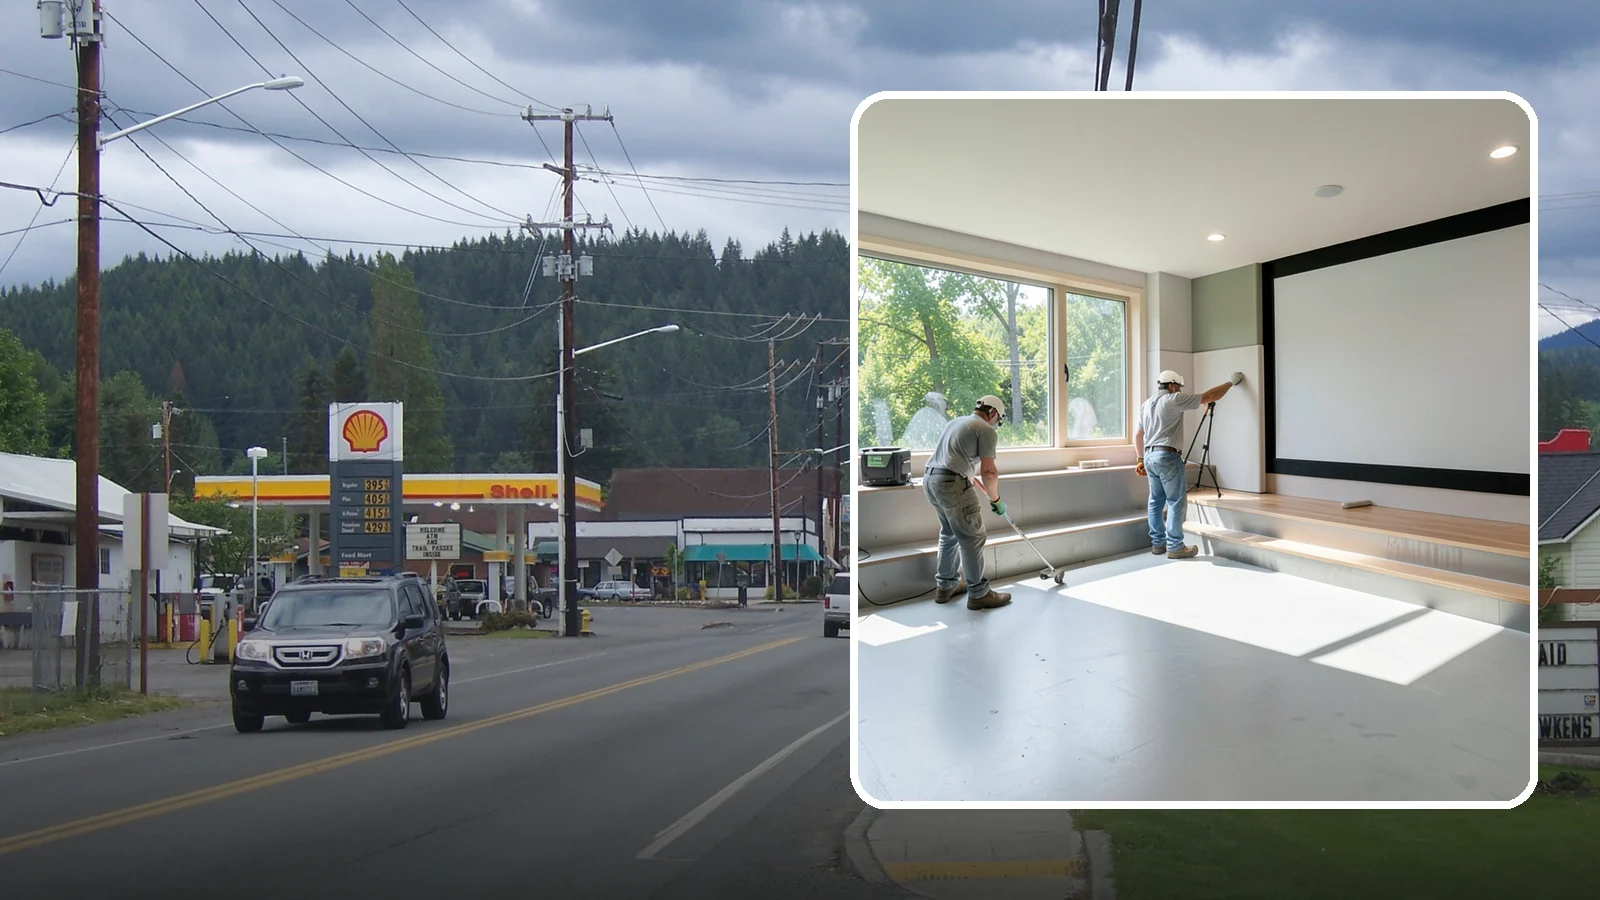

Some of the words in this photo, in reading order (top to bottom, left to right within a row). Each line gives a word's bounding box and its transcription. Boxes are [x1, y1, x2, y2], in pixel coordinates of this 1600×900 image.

[366, 480, 384, 490] 395
[490, 484, 547, 498] Shell
[366, 494, 384, 504] 405
[366, 508, 383, 518] 415
[366, 522, 383, 532] 429
